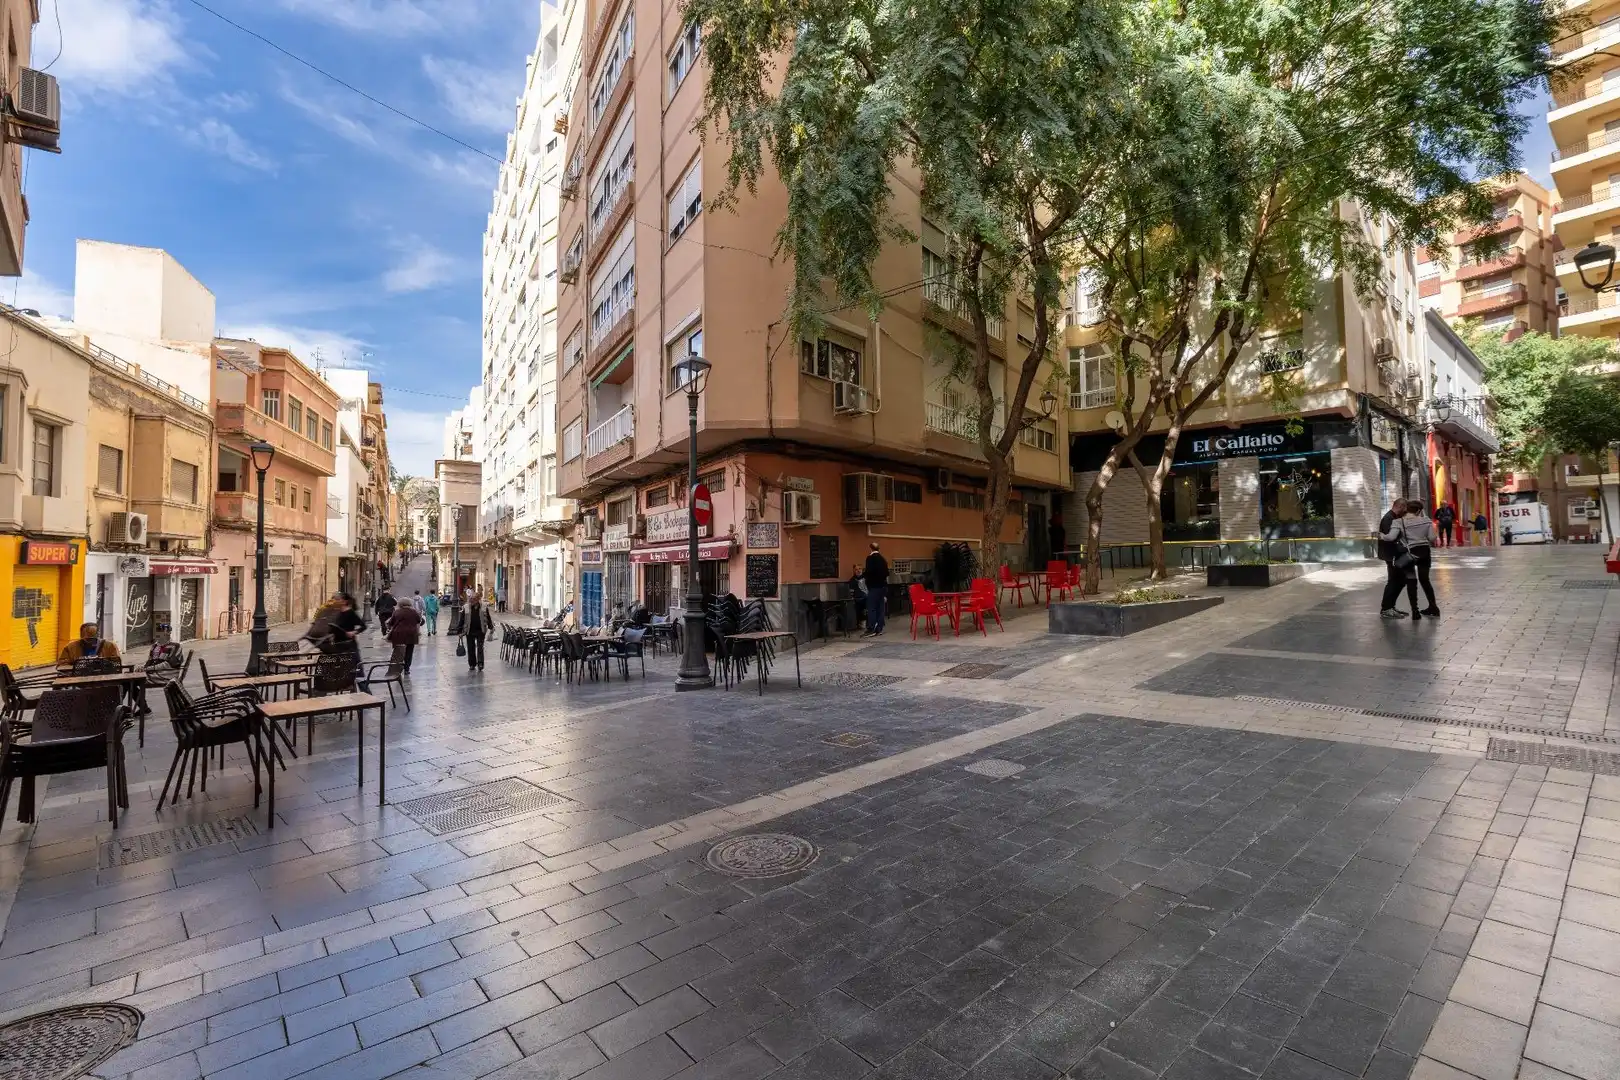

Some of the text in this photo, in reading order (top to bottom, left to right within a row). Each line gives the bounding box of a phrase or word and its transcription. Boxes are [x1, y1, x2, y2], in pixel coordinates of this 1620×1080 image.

[1193, 433, 1284, 453] El Callaito
[30, 546, 76, 561] SUPER 8
